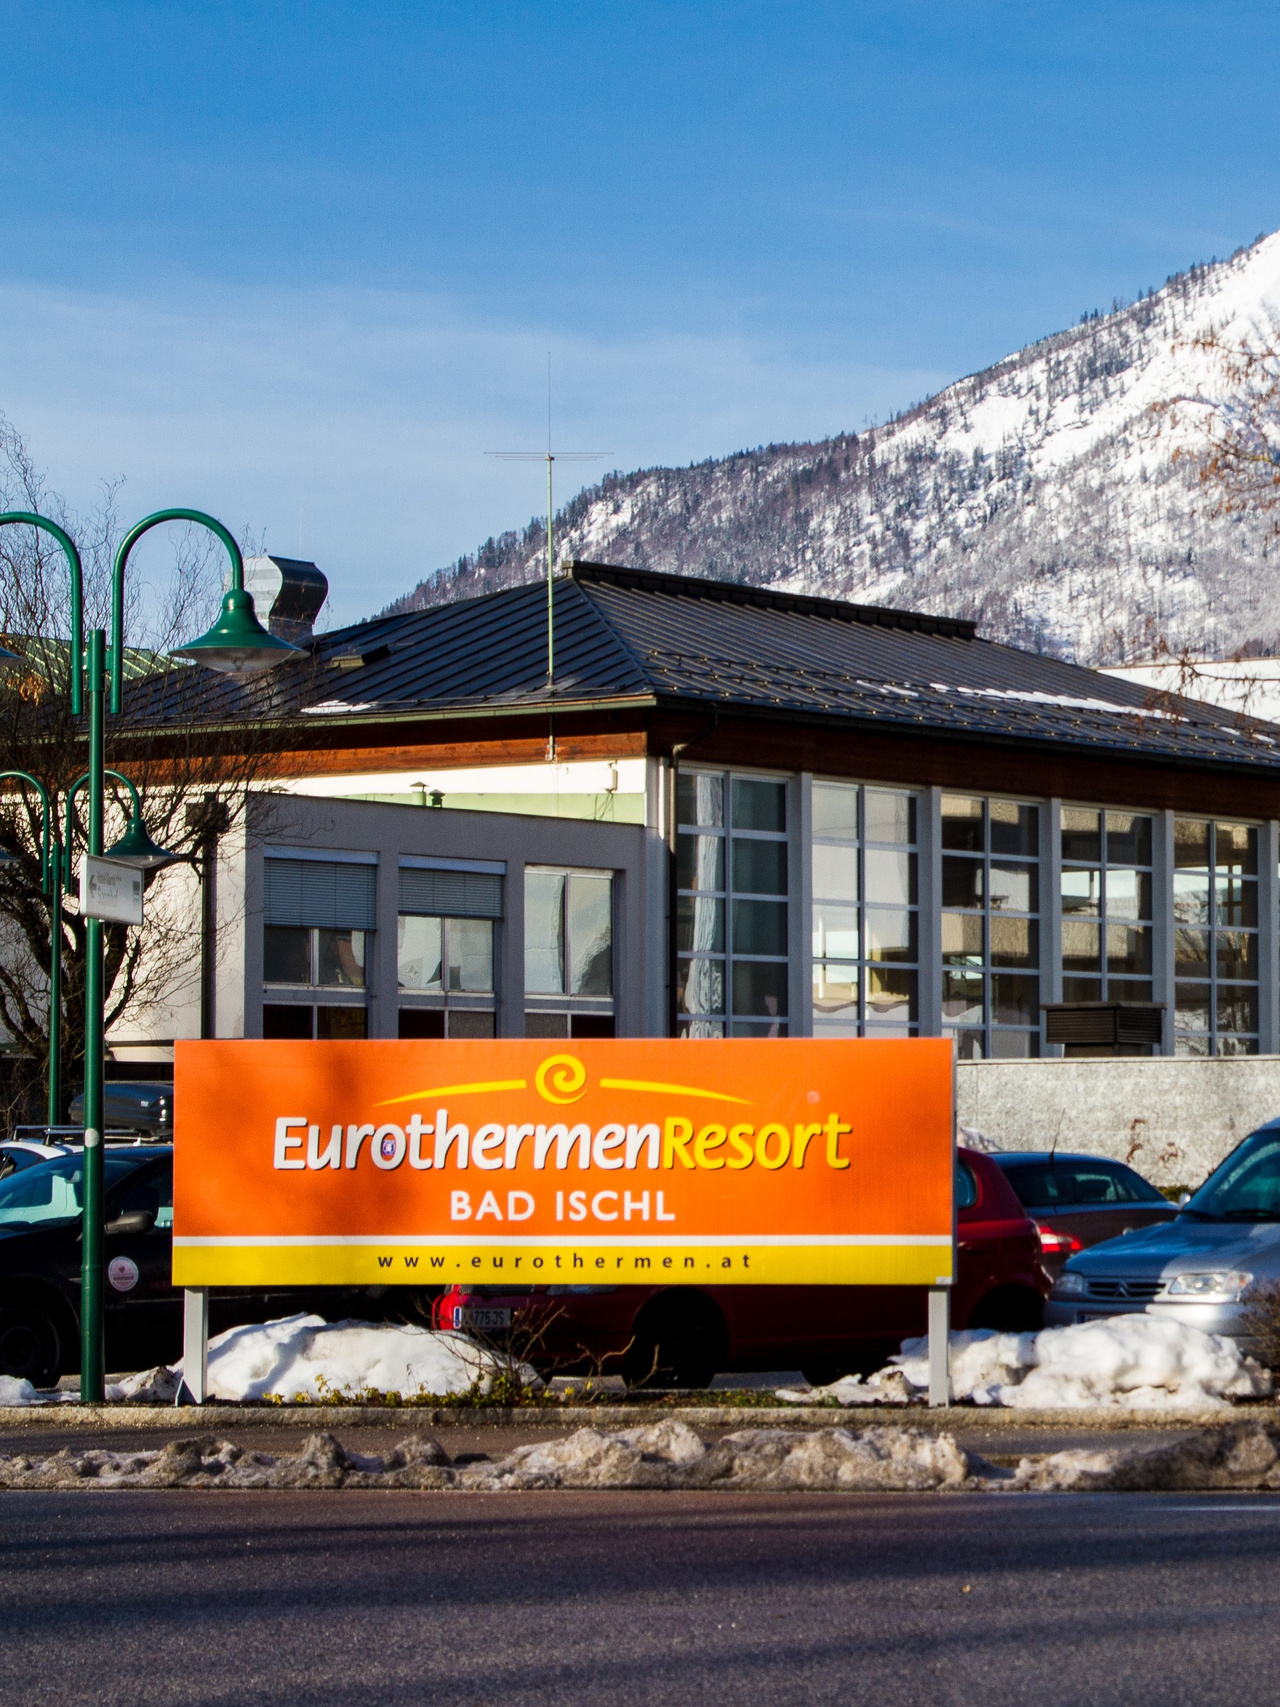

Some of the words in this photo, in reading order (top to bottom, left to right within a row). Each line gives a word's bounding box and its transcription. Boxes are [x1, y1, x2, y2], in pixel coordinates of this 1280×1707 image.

[450, 1190, 535, 1221] BAD
[556, 1190, 676, 1222] ISCHL
[377, 1253, 753, 1269] www.eurothermen.at
